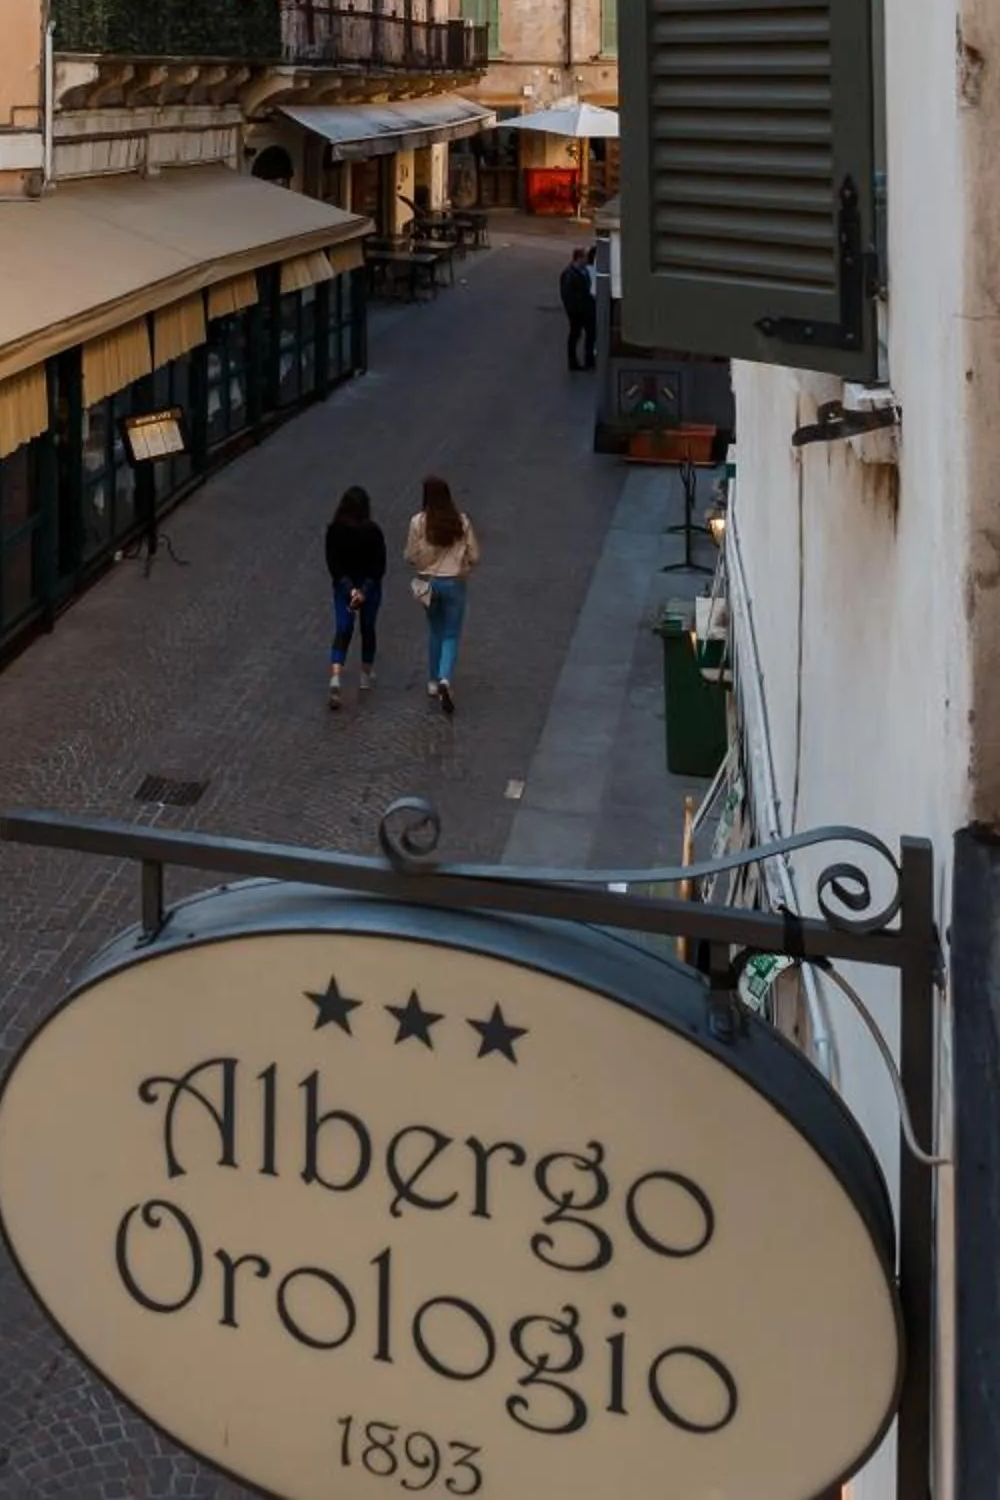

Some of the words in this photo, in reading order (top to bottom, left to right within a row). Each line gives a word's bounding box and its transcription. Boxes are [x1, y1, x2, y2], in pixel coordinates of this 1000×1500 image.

[137, 1056, 716, 1274] Albergo
[114, 1198, 740, 1436] Orologio
[337, 1414, 483, 1496] 1893
